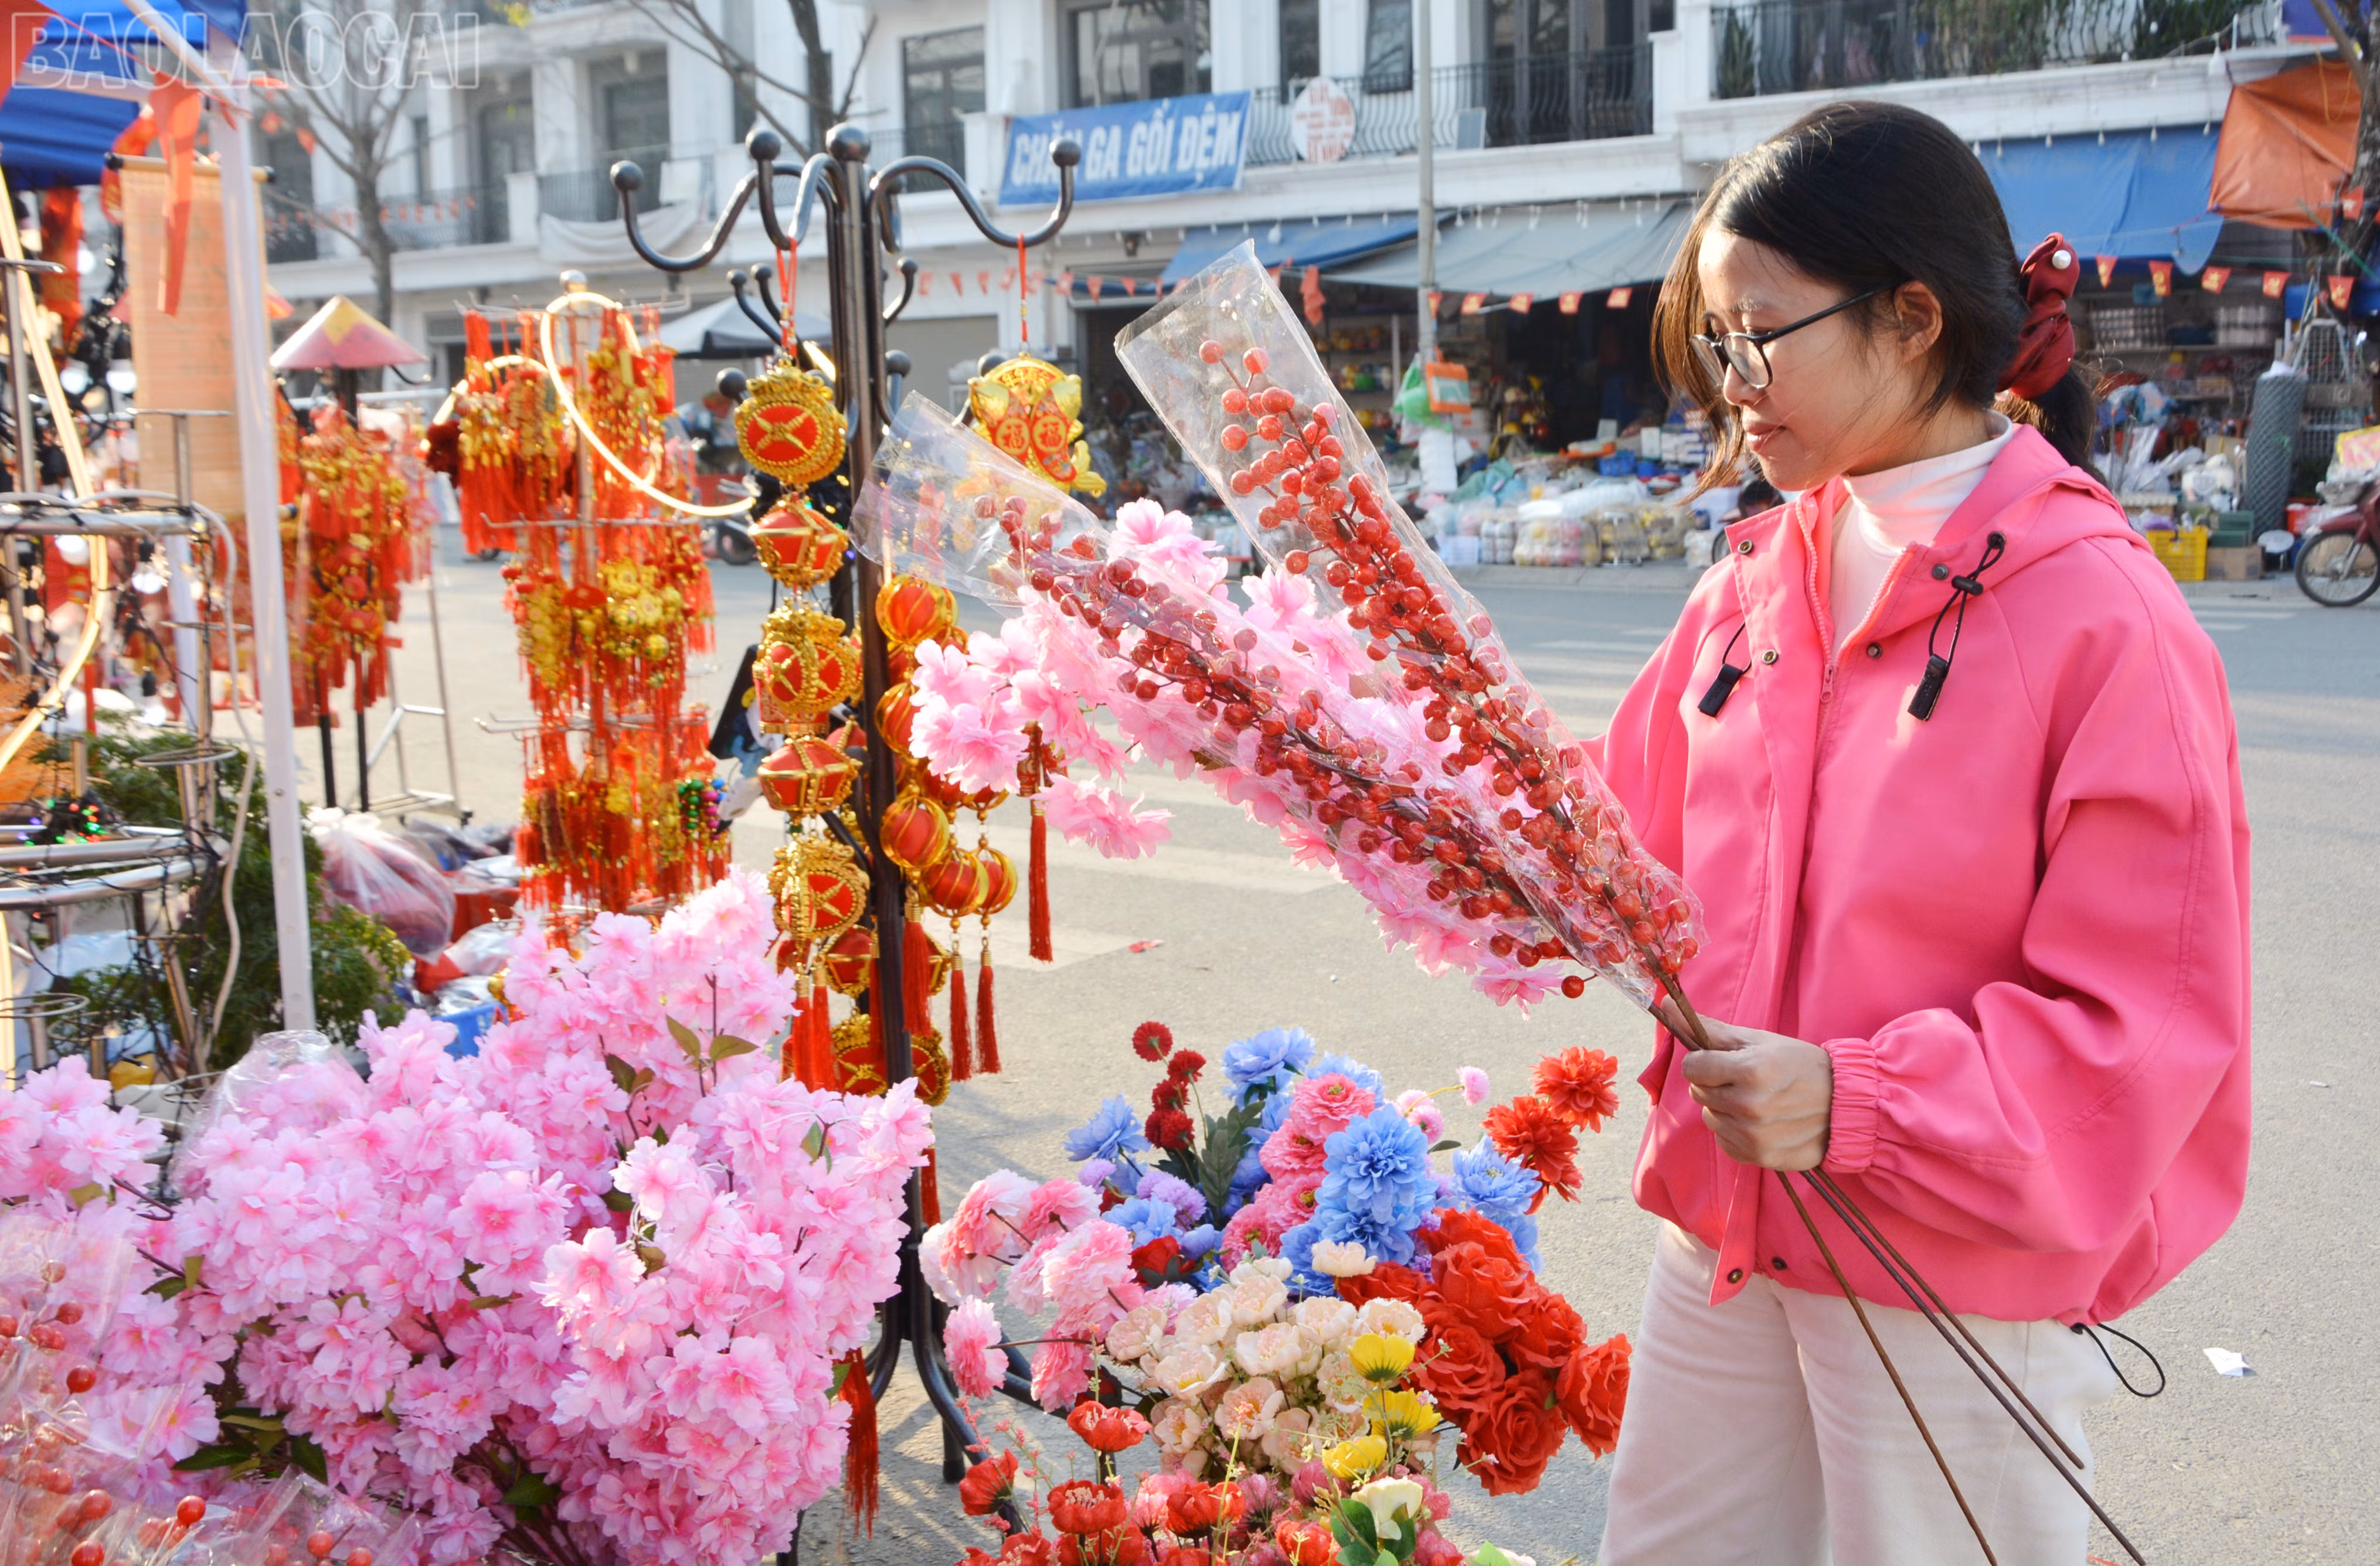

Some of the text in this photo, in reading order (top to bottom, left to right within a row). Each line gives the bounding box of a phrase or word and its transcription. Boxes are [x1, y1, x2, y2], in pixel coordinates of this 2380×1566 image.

[1085, 124, 1122, 182] GA
[1126, 97, 1176, 178] GỐI
[1177, 101, 1242, 183] ĐỆM
[1001, 423, 1025, 450] 福
